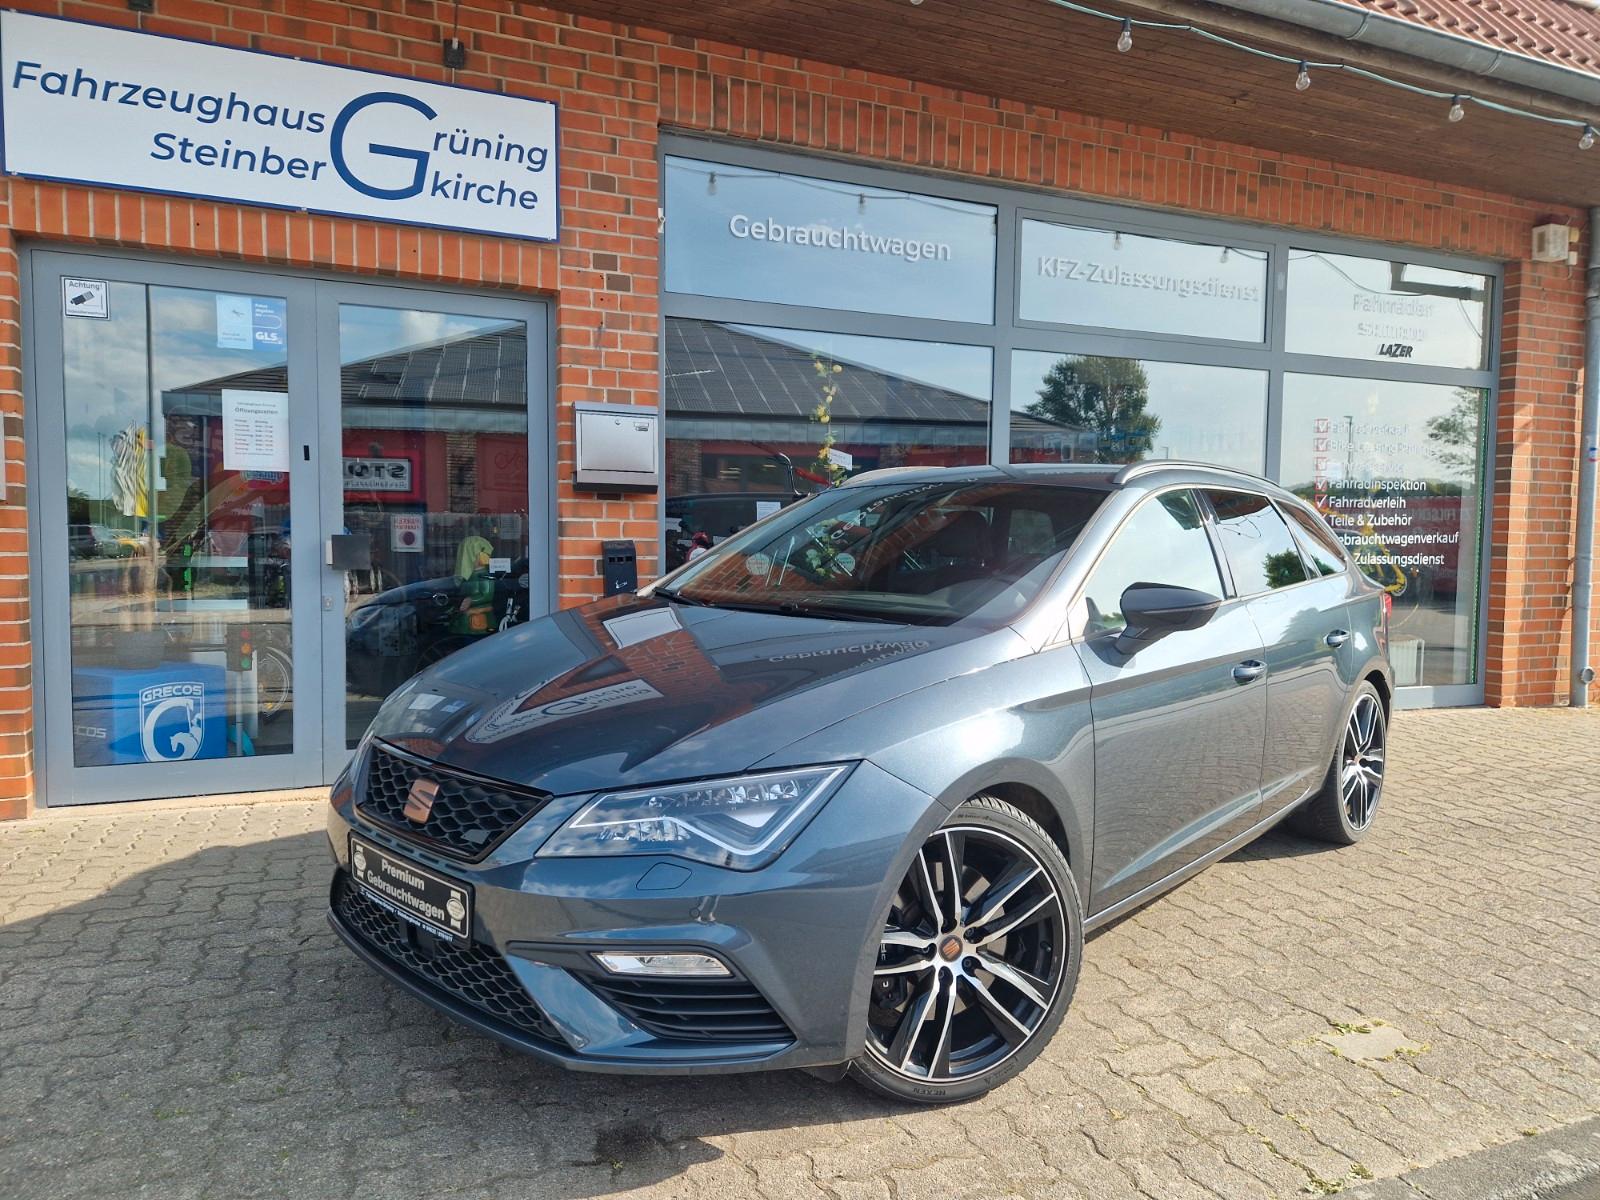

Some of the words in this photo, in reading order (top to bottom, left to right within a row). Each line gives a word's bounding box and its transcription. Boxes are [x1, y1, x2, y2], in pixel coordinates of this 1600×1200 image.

[12, 61, 326, 134] Fahrzeughaus
[430, 170, 539, 210] kirche
[729, 213, 952, 263] Gebrauchtwagen
[1037, 255, 1259, 303] KFZ-Zulassungsdienst
[255, 331, 279, 342] GLS
[1378, 343, 1414, 358] LAZER
[1329, 478, 1427, 493] Fahrradinspektion
[1328, 495, 1407, 509] Fahrradverleih
[1329, 513, 1355, 527] Teile
[1357, 514, 1365, 526] &
[1366, 513, 1412, 527] Zubehör
[1338, 531, 1460, 547] ebrauchtwagenverkauf
[1353, 551, 1445, 567] Zulassungsdienst
[142, 684, 203, 702] GRECOS
[381, 858, 425, 891] Premium
[367, 868, 445, 921] Gebrauchtwagen
